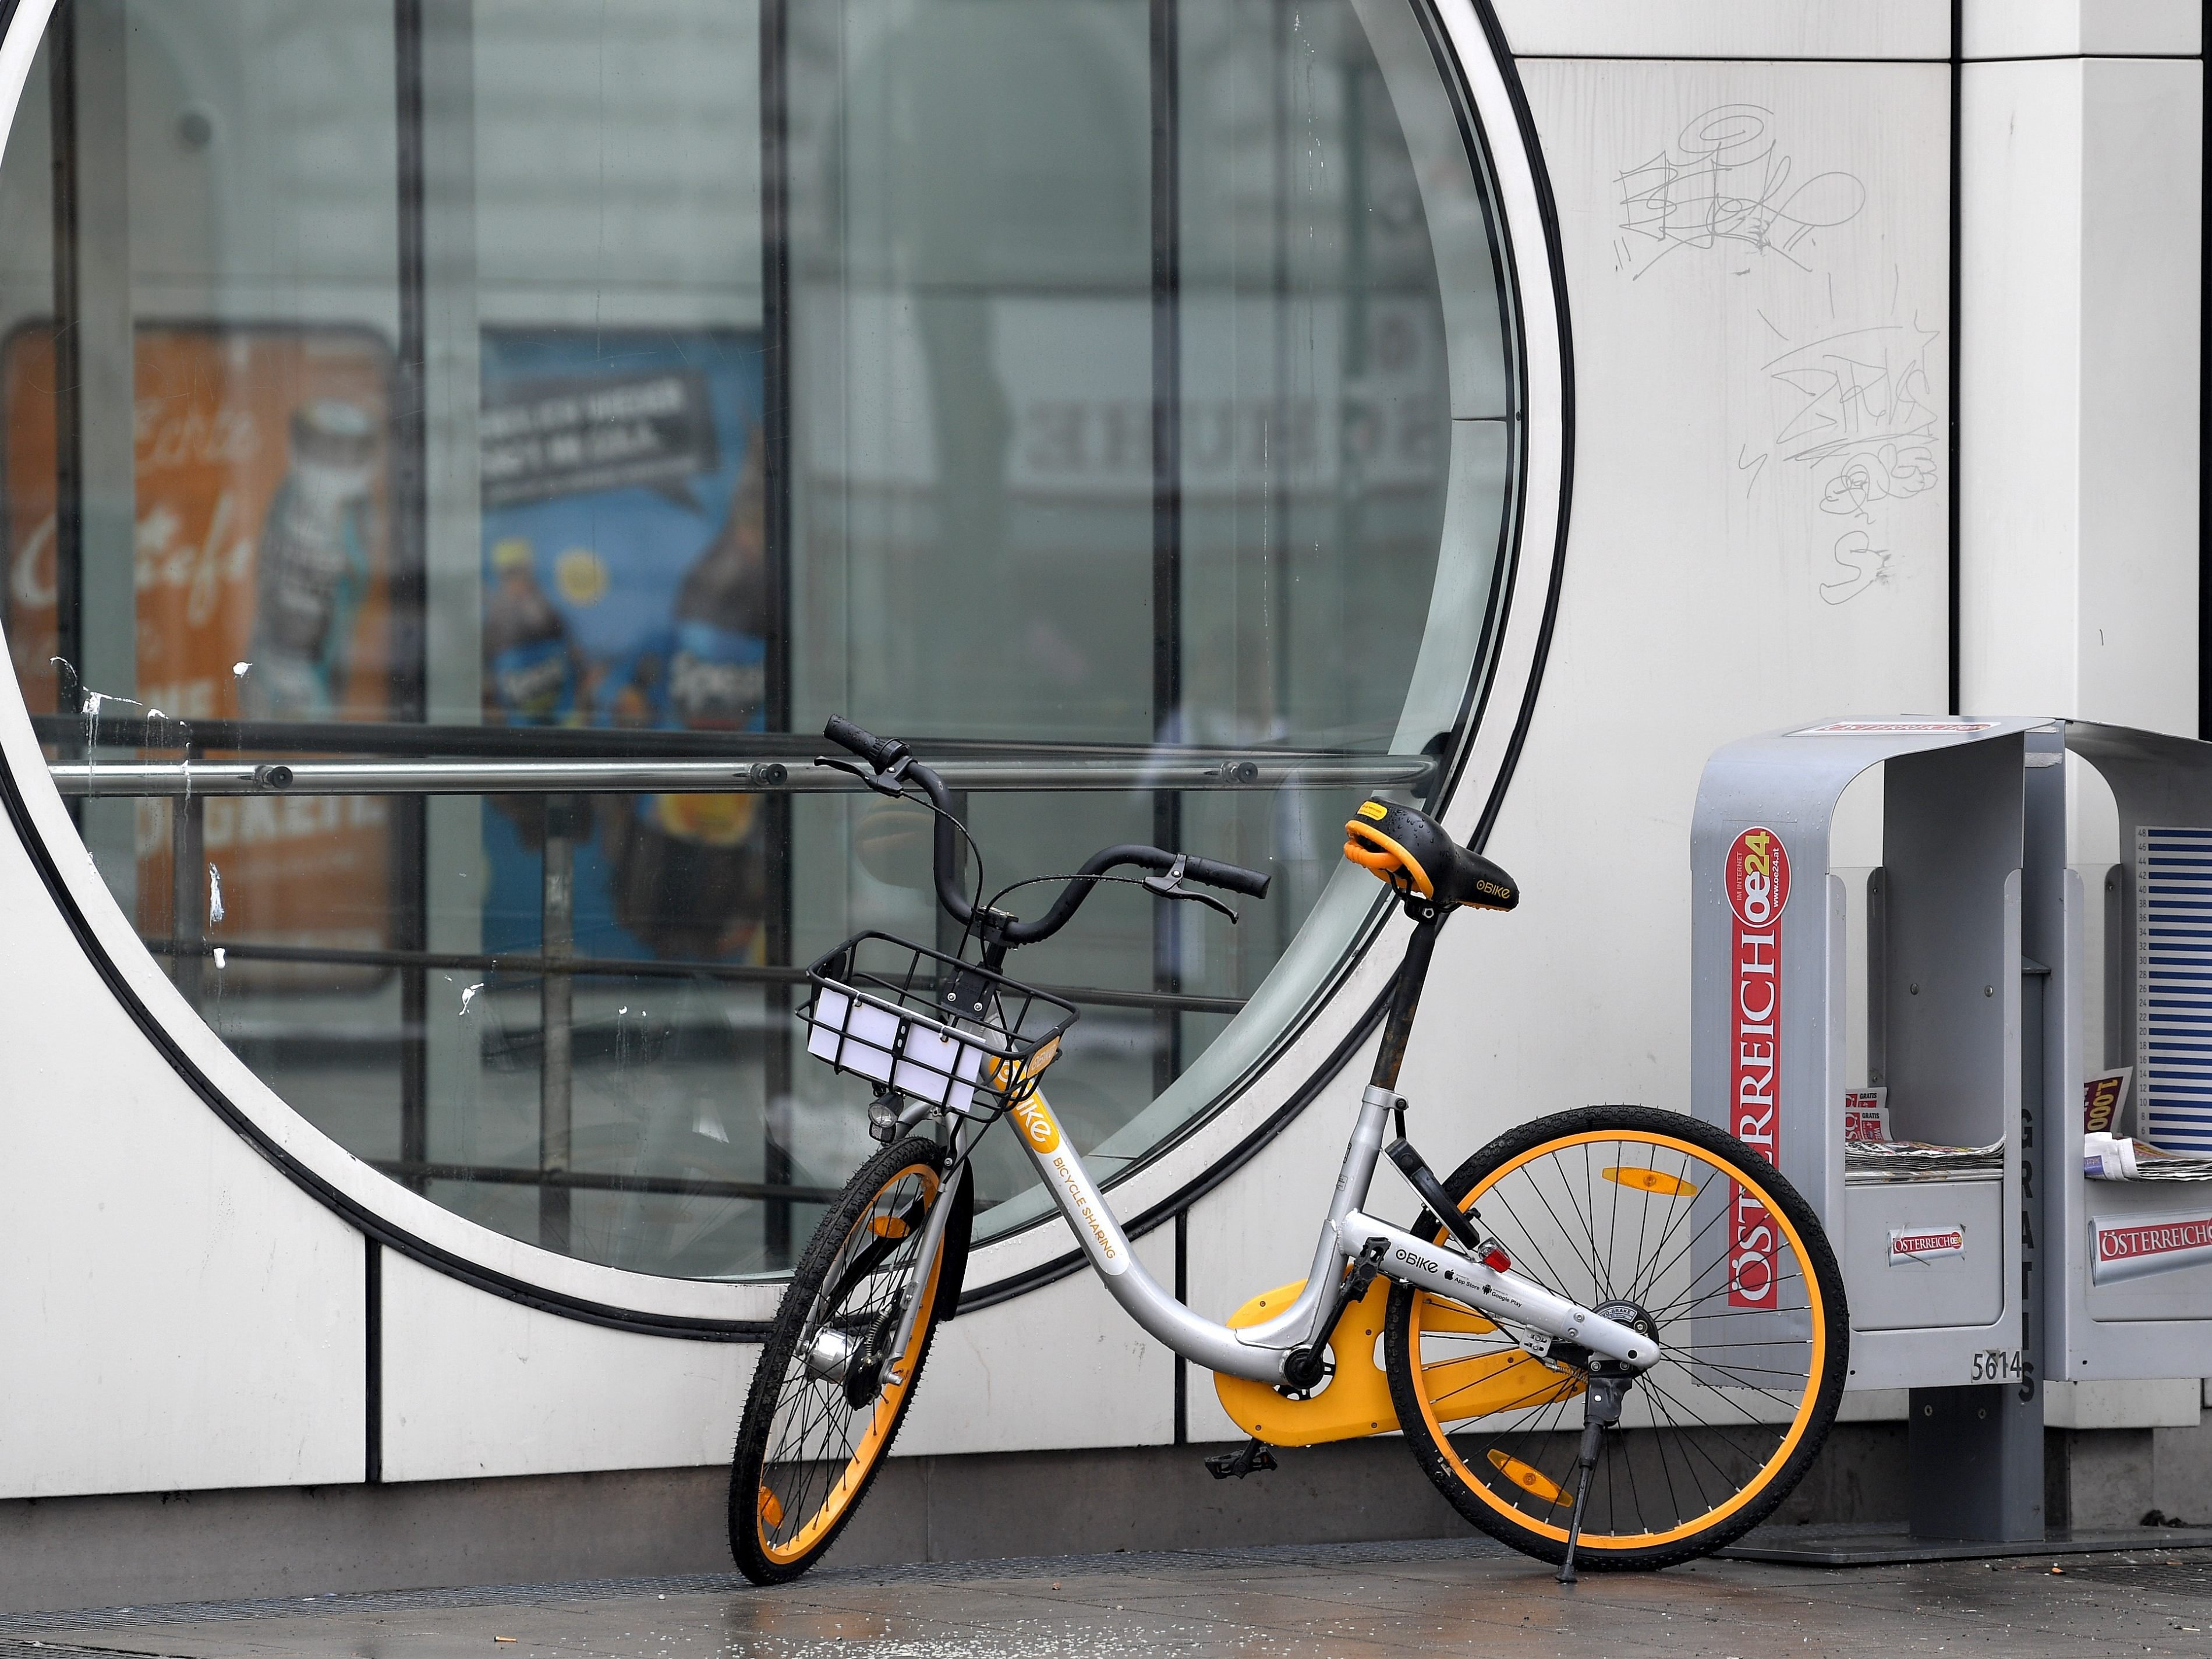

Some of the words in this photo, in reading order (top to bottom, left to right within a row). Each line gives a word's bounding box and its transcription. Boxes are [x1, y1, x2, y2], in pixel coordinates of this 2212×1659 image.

[2138, 843, 2147, 851] 46
[1744, 832, 1771, 923] oe24
[1736, 889, 1742, 901] IM
[2139, 914, 2147, 922] 36
[2139, 971, 2147, 979] 28
[2139, 985, 2147, 993] 26
[2139, 1013, 2147, 1021] 22
[2140, 1056, 2147, 1064] 16
[2140, 1098, 2147, 1106] 10
[1732, 929, 1775, 1301] ÖSTRREICH
[1053, 1156, 1087, 1207] BICYCLE
[1082, 1207, 1116, 1259] SHARING
[2101, 1225, 2207, 1257] ÖSTERREICH
[1466, 1282, 1480, 1290] Store
[1491, 1292, 1510, 1302] Google
[1510, 1299, 1522, 1308] Play
[1599, 1308, 1630, 1317] VO-BRAKE
[1972, 1350, 2022, 1381] 5614
